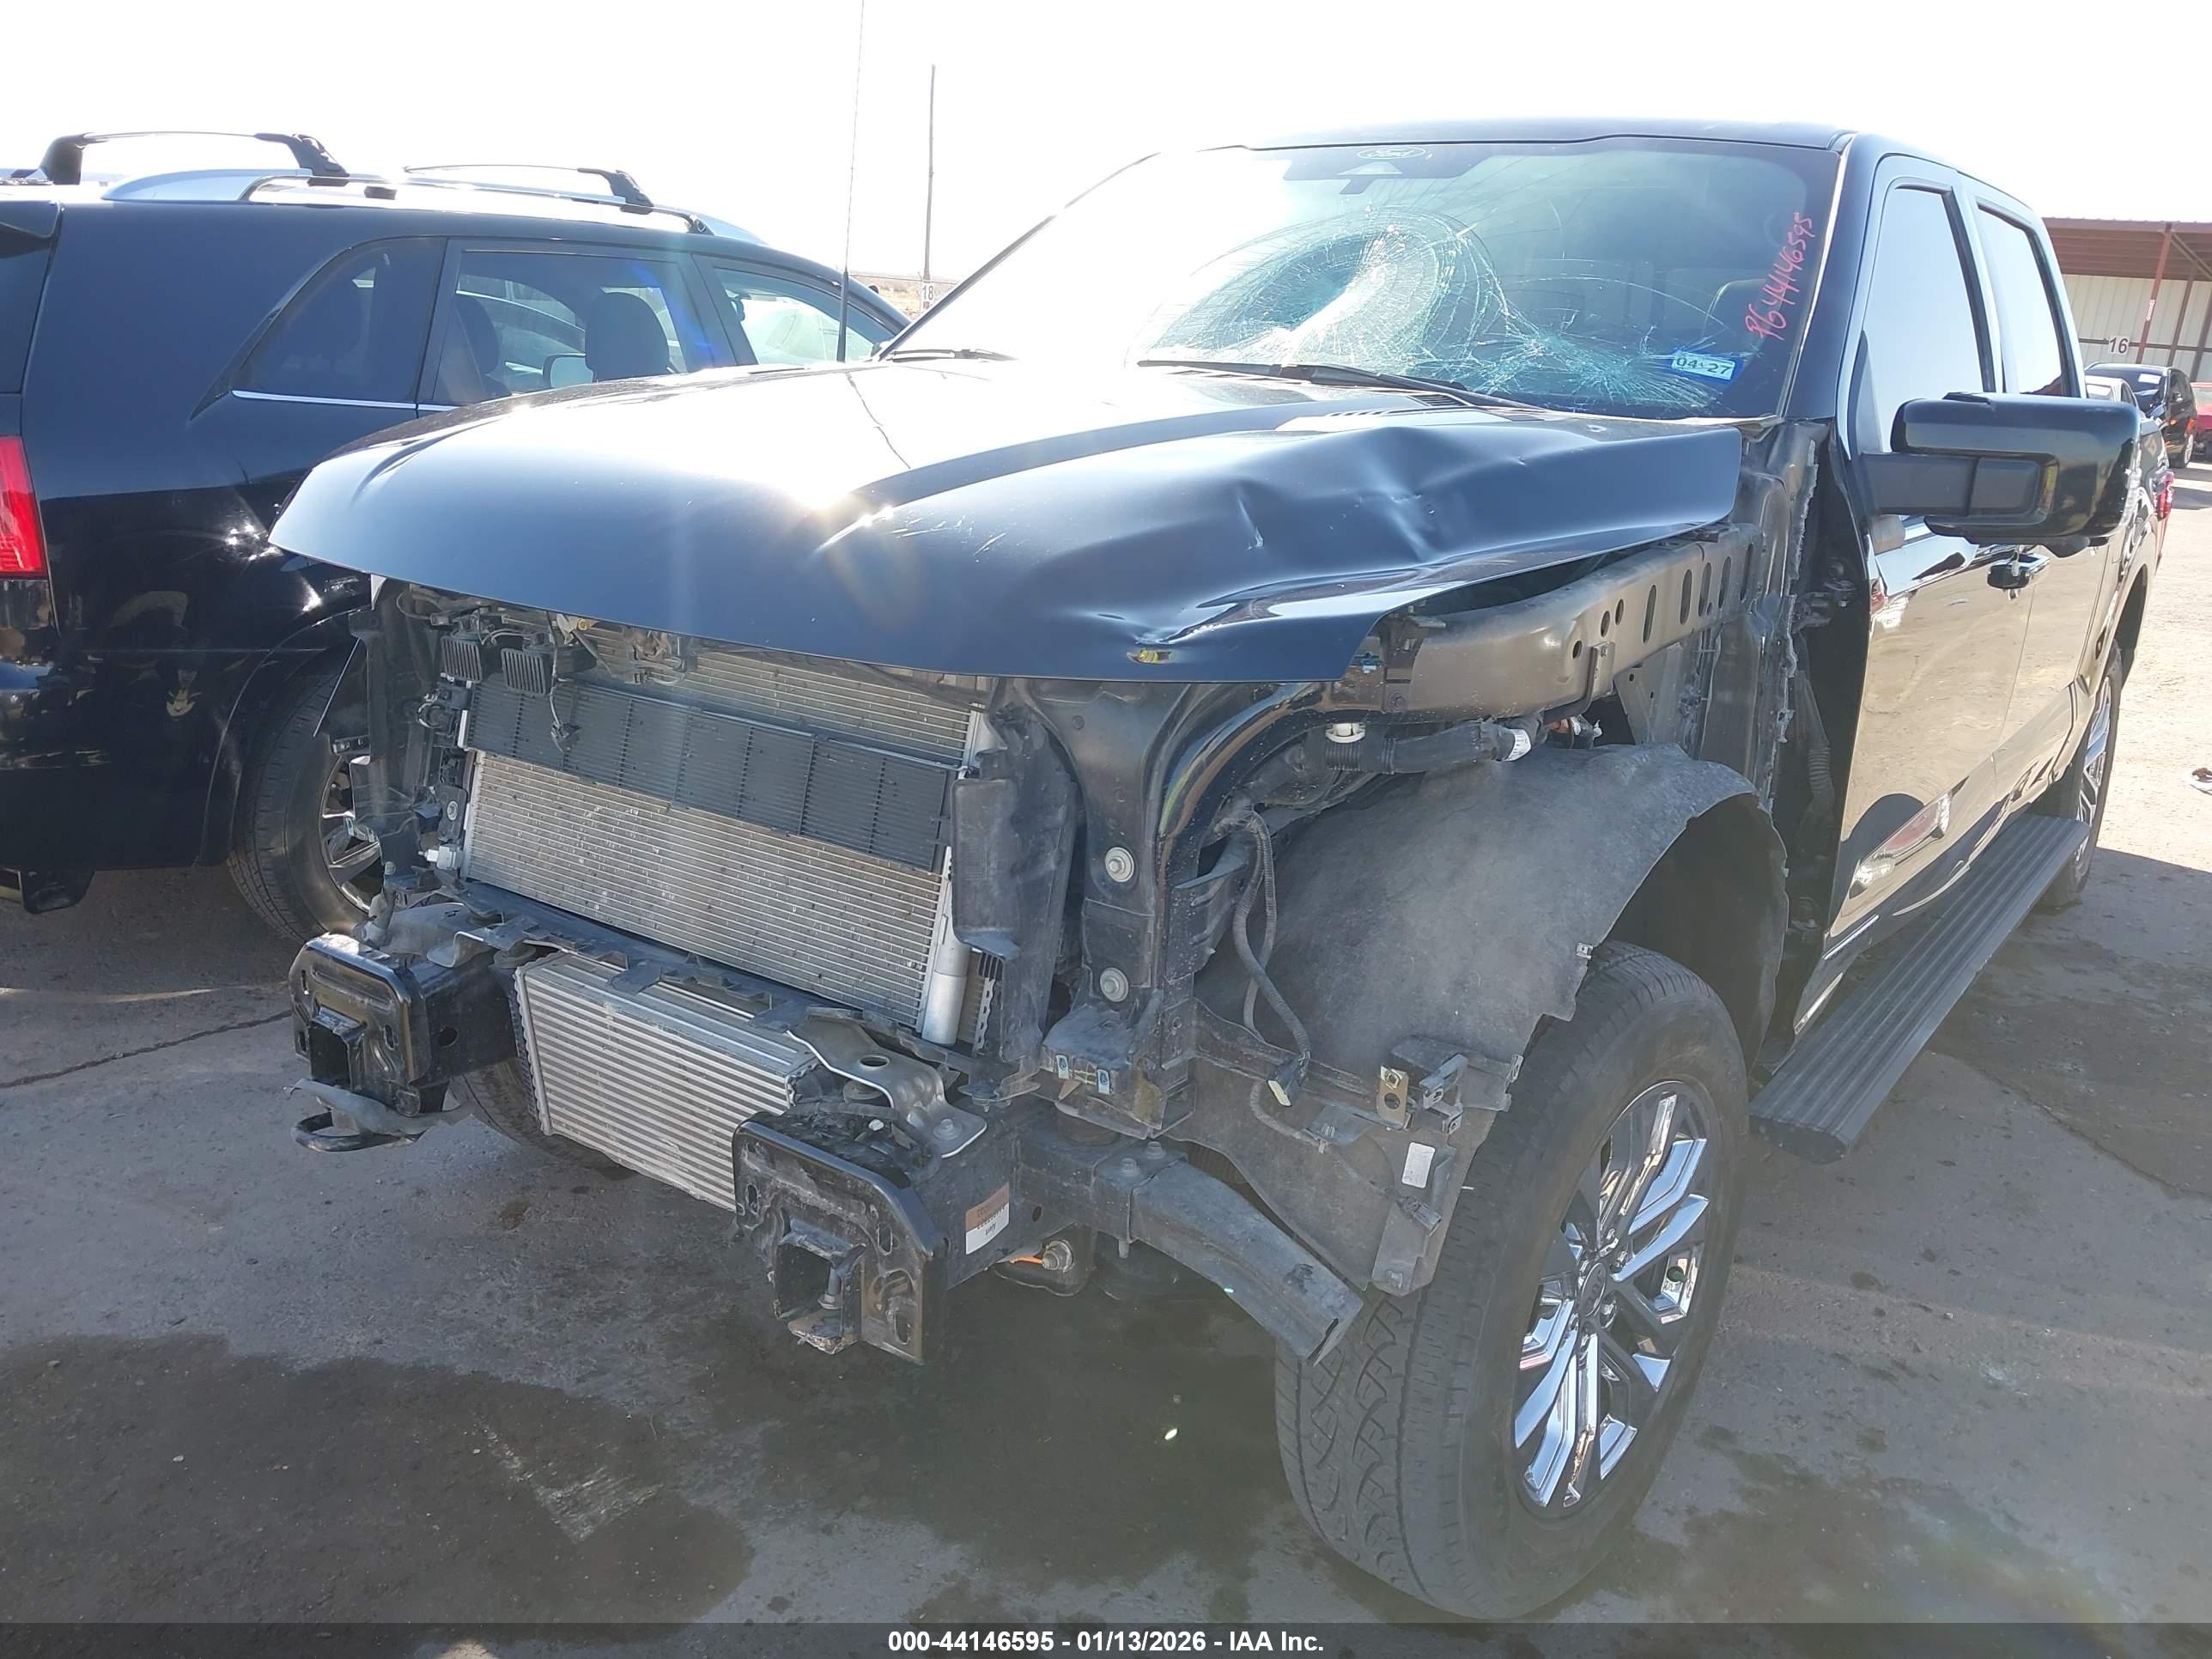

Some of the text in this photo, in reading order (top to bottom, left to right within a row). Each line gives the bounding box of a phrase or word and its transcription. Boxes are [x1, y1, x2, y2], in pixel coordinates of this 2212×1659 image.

[921, 284, 934, 301] 18
[2110, 337, 2129, 354] 16
[1676, 356, 1732, 375] 04 27
